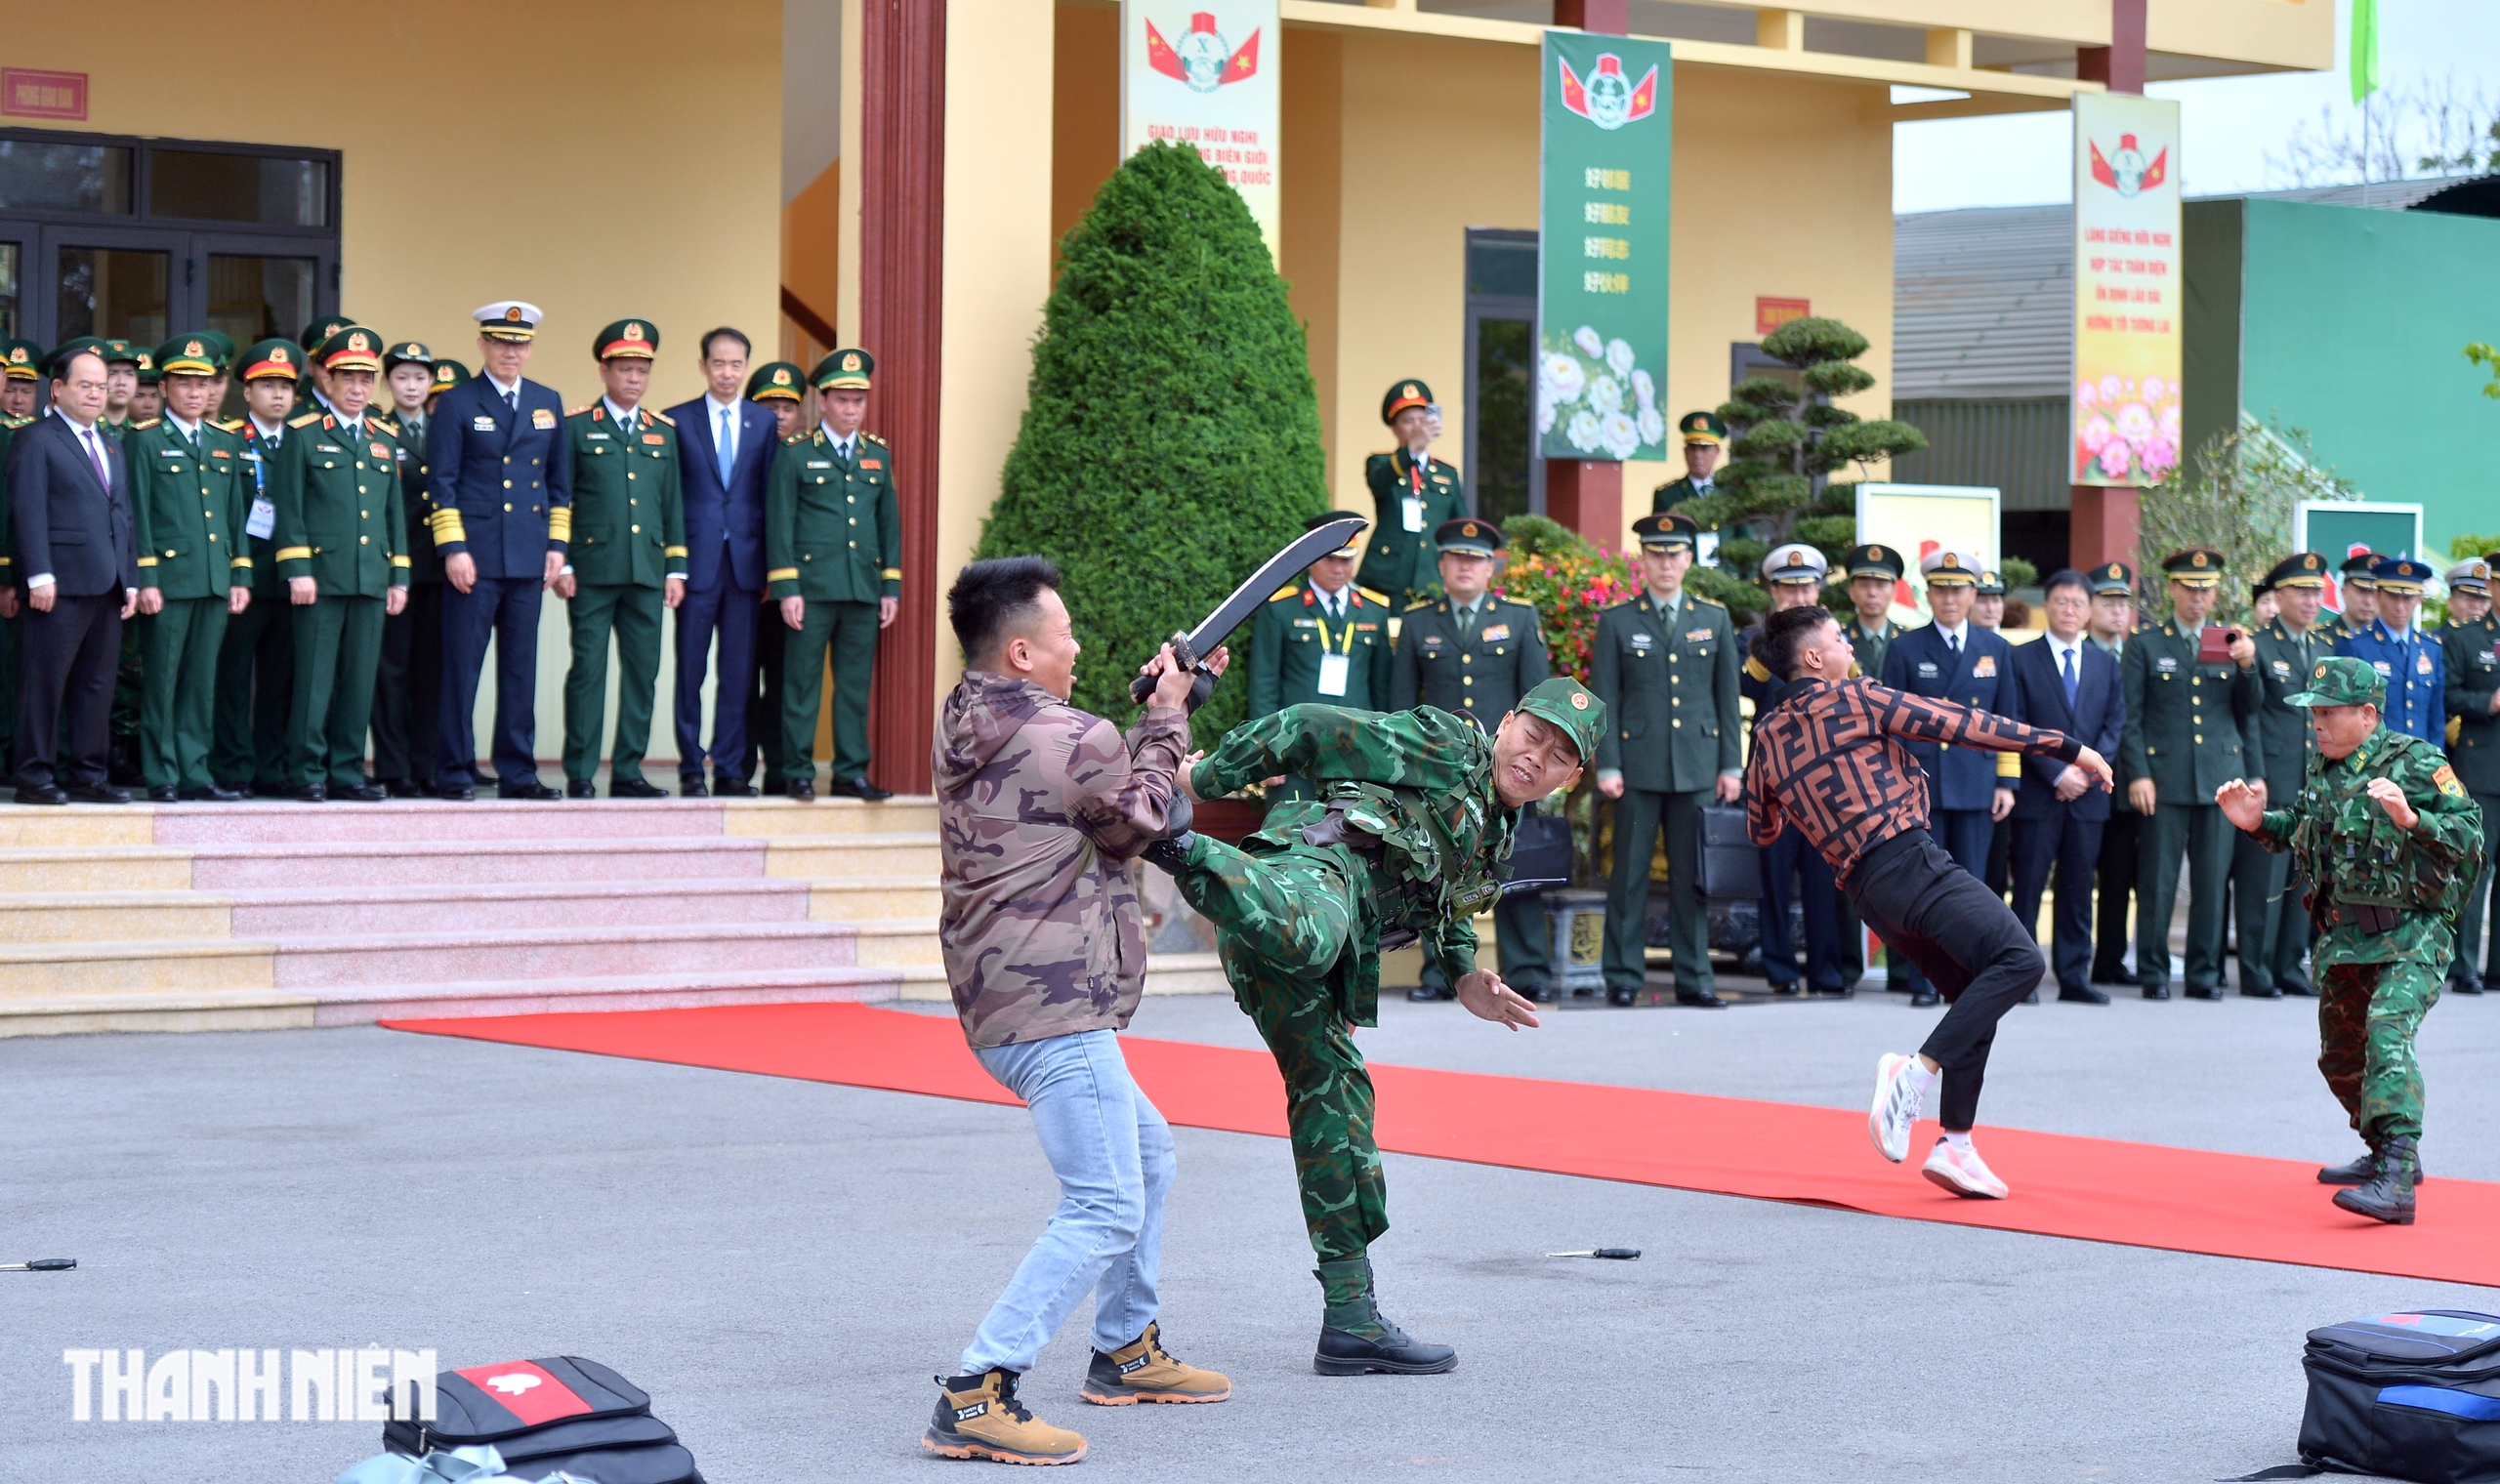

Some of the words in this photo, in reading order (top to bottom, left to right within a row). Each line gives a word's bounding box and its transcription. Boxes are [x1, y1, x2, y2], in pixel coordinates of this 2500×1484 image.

[1147, 125, 1175, 140] GIAO
[1179, 125, 1200, 141] LƯU
[1204, 127, 1228, 143] HỮU
[1230, 130, 1258, 146] NGHỊ
[1215, 147, 1241, 163] BIÊN
[1244, 148, 1268, 165] GIỚI
[1241, 168, 1271, 186] QUỐC
[1584, 167, 1631, 190] 好邻居
[1584, 201, 1631, 225] 好朋友
[1583, 235, 1630, 260] 好同志
[1583, 270, 1630, 294] 好伙伴
